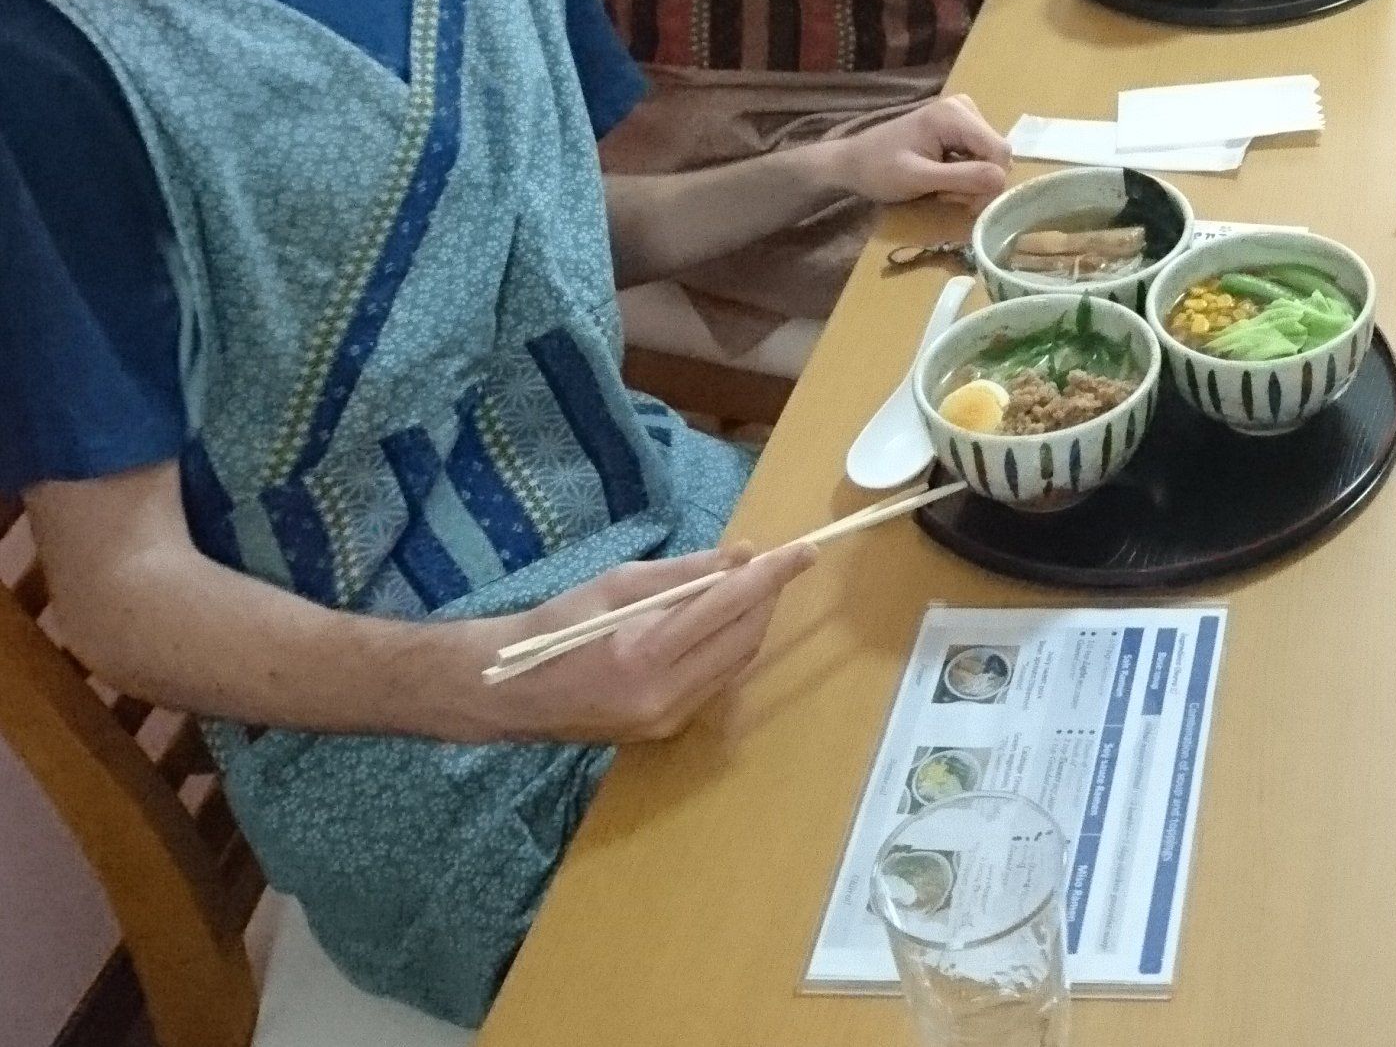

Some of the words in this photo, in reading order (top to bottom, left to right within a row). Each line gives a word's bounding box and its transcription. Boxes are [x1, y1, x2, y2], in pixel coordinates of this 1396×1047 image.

[1119, 654, 1133, 668] Salt
[1113, 670, 1129, 697] Ramen
[1179, 702, 1200, 758] Combination
[1178, 760, 1190, 771] of
[1172, 772, 1187, 796] soup
[1089, 785, 1105, 815] Ramen
[1170, 798, 1183, 816] and
[1161, 818, 1180, 861] toppings
[1071, 864, 1089, 888] Miso
[1064, 889, 1083, 921] Ramen
